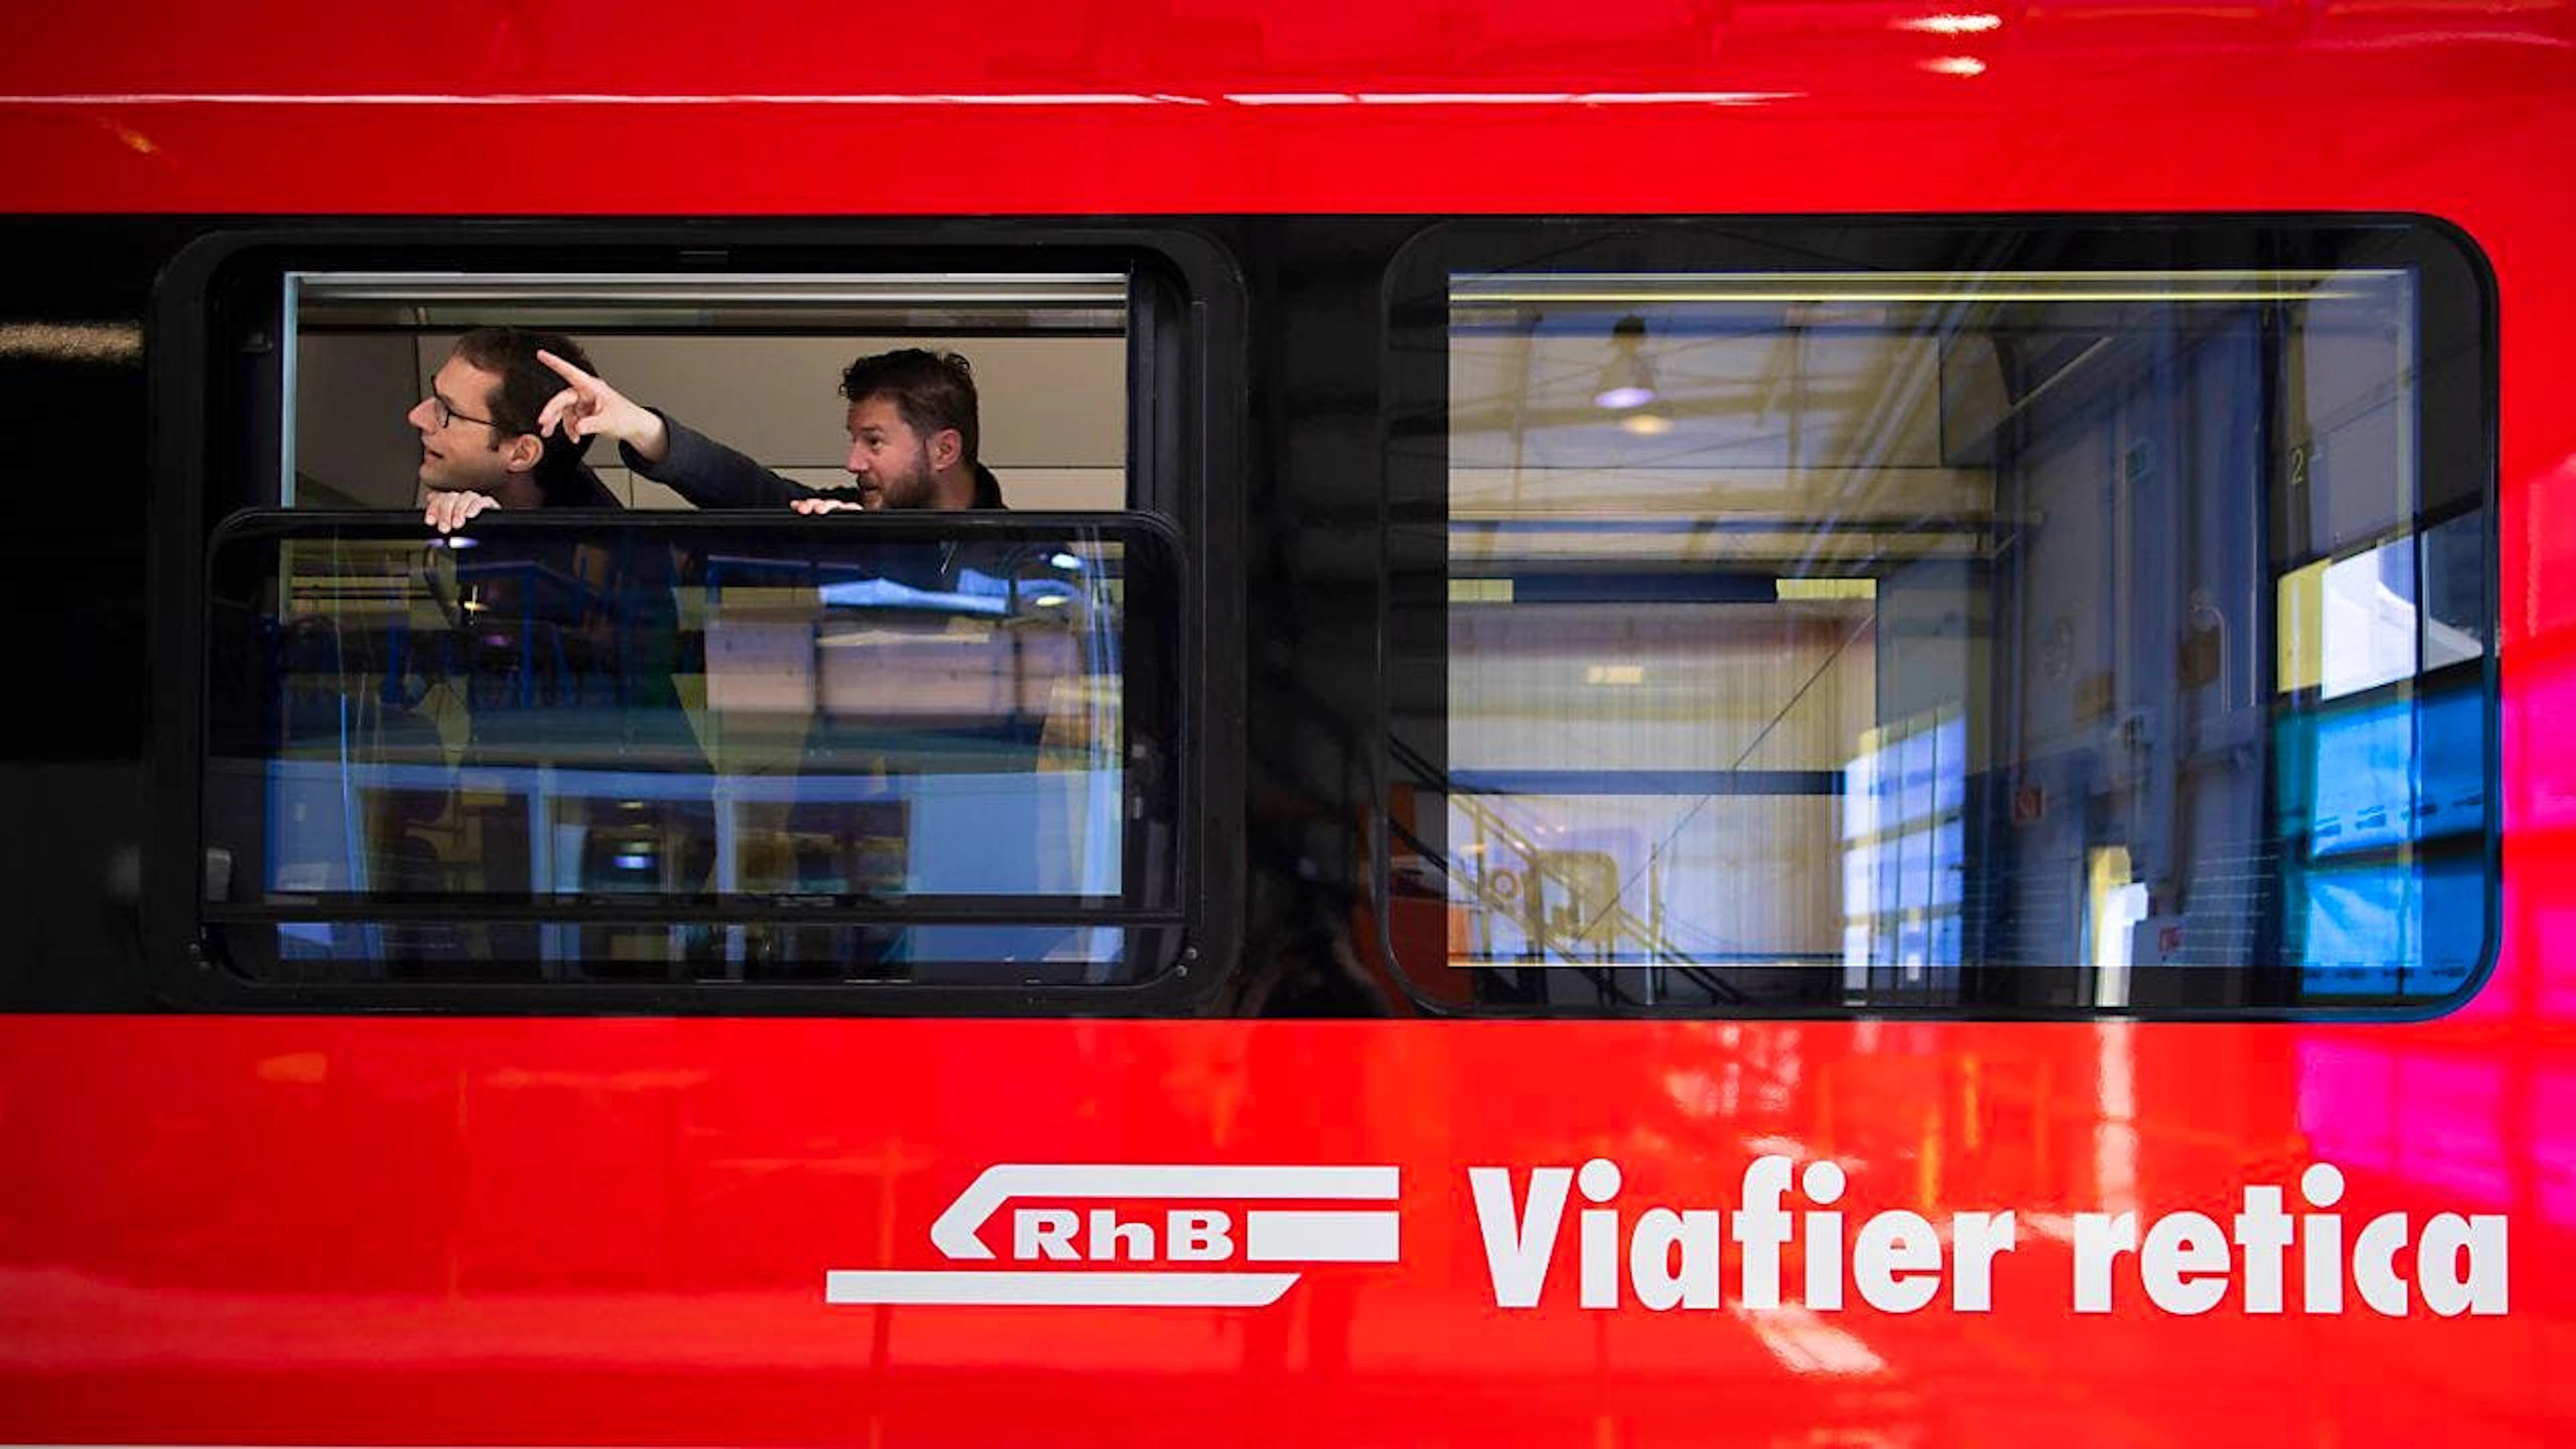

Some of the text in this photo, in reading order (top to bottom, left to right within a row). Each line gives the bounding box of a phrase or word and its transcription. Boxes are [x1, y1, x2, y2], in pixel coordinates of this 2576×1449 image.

[2291, 449, 2304, 484] 2
[1014, 1210, 1234, 1261] RhB
[1469, 1156, 2509, 1316] Viafier retica
